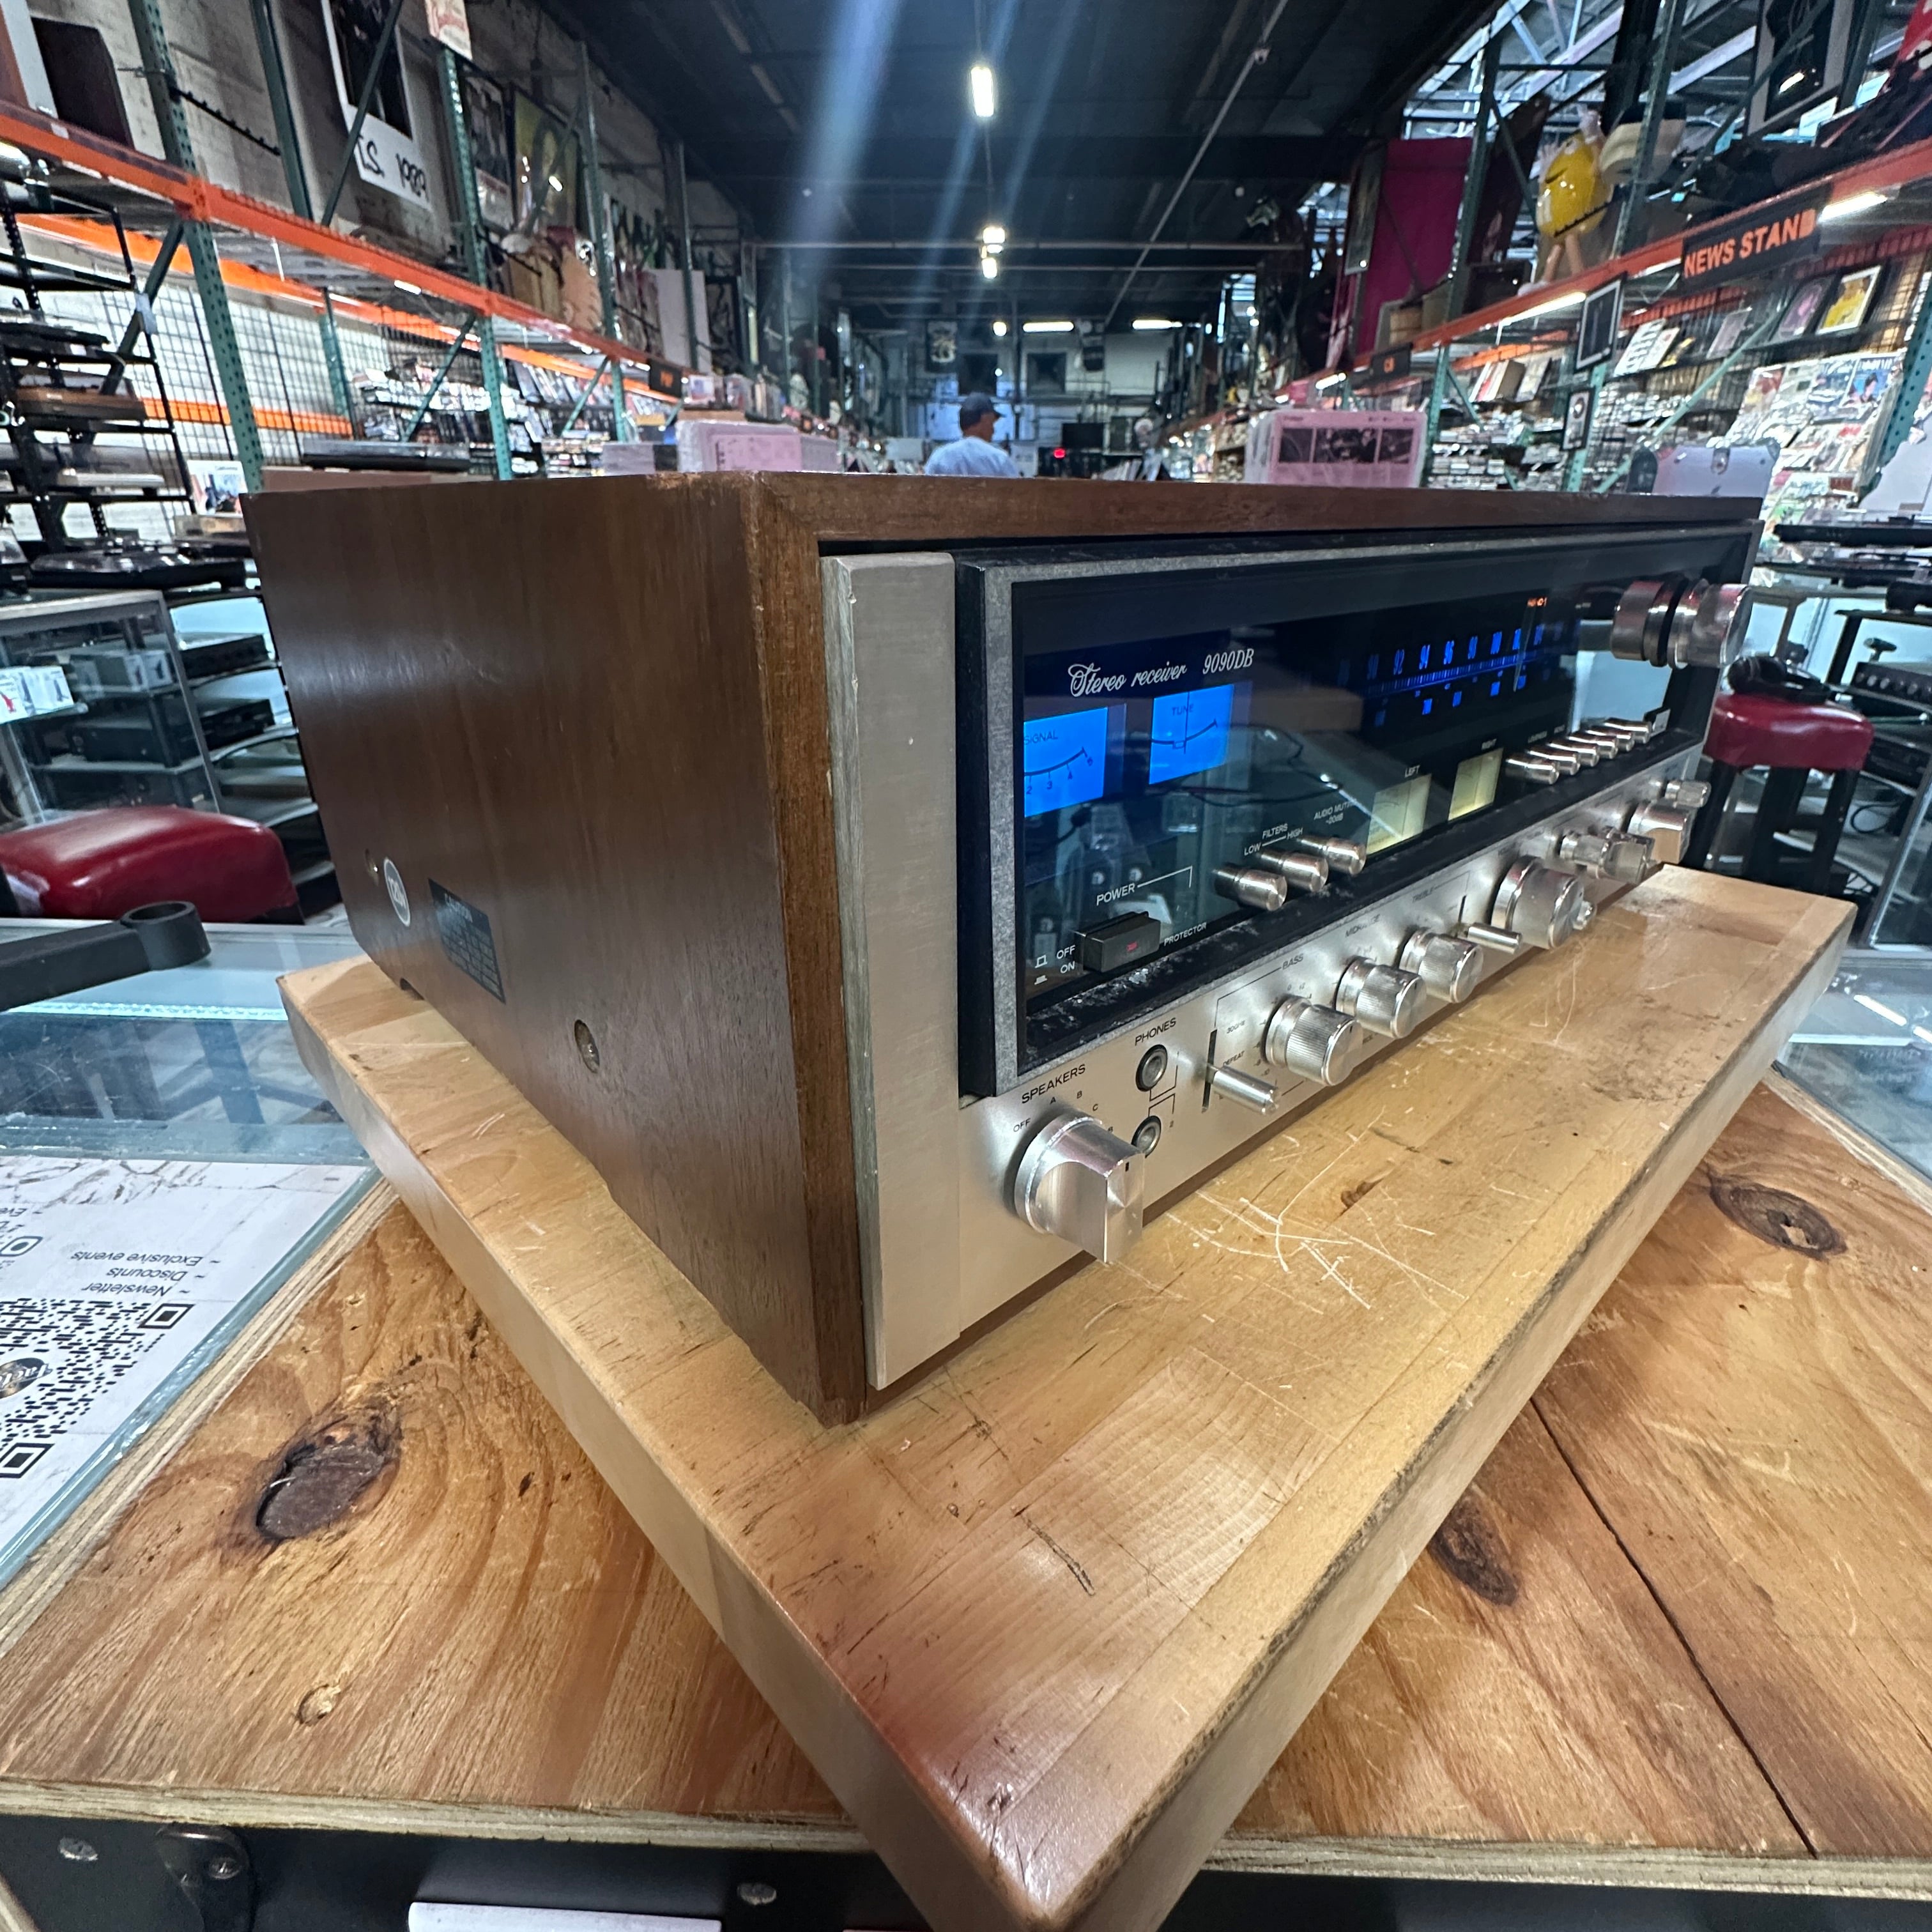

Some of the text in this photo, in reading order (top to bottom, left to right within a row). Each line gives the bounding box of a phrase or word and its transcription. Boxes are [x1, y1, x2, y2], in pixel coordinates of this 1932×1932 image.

[1684, 208, 1816, 279] NEWS STAND
[1068, 648, 1255, 698] Stereo receiver 9090DB
[1171, 703, 1194, 716] TUNE
[1023, 729, 1059, 746] SIGNAL
[1404, 764, 1421, 778] LEFT
[1026, 786, 1032, 795] 2
[1046, 781, 1053, 790] 3
[1313, 806, 1333, 820] AUDIO
[1262, 823, 1289, 839] FILTERS
[1243, 827, 1304, 857] LOW HIGH
[1096, 882, 1136, 906] POWER
[1163, 921, 1208, 947] PROTECTOR
[1055, 944, 1077, 960] OFF
[1060, 960, 1076, 974] ON
[1282, 953, 1305, 970] BASS
[1135, 1017, 1177, 1046] PHONES
[1021, 1063, 1087, 1105] SPEAKERS
[1049, 1096, 1057, 1105] A
[1076, 1091, 1083, 1100] B
[1092, 1103, 1099, 1112] C
[1013, 1118, 1031, 1133] OFF
[70, 1251, 203, 1266] Exclusive events
[106, 1267, 188, 1282] Discounts
[81, 1282, 172, 1297] Newsletter
